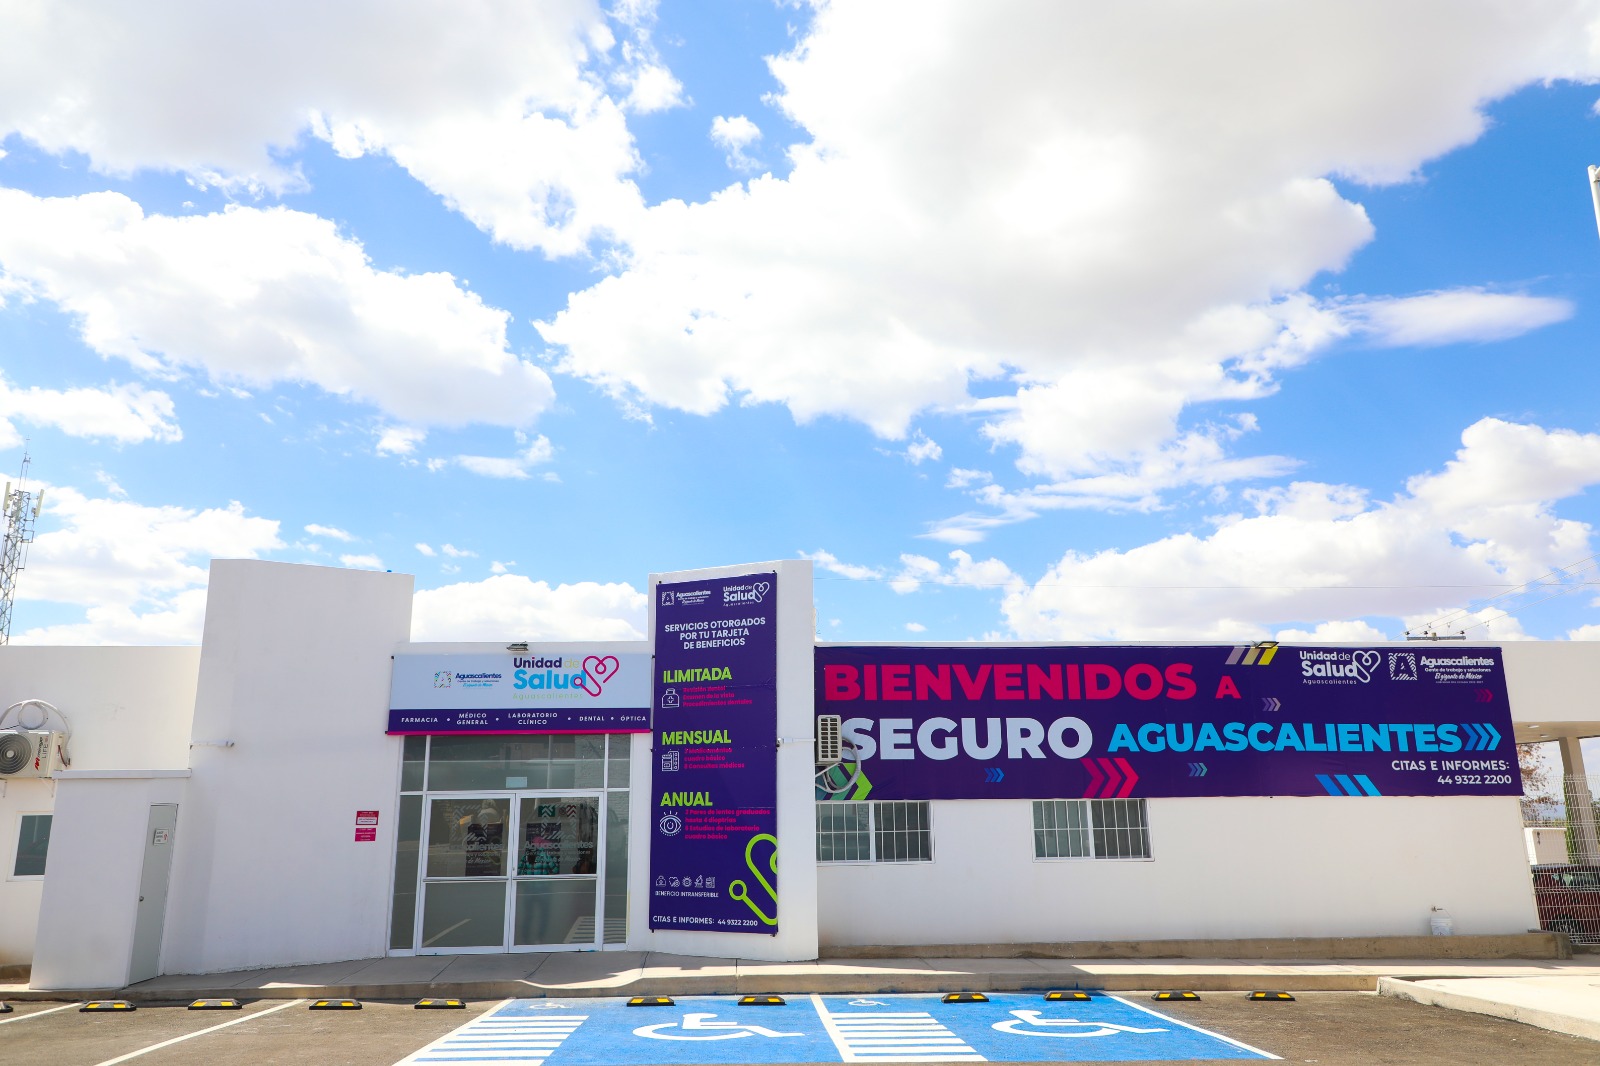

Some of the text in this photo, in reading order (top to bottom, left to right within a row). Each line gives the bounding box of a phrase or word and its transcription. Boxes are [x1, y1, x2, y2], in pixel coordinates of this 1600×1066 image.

[723, 590, 756, 602] Salud
[664, 617, 766, 632] SERVICIOS OTORGADOS
[680, 628, 750, 640] POR TU TARJETA
[684, 638, 746, 650] DE BENEFICIOS
[1300, 650, 1351, 660] Unidad de
[513, 657, 580, 668] Unidad de
[1420, 656, 1495, 668] Aguascalientes
[1301, 660, 1358, 677] Salud
[456, 672, 502, 680] Aguascalientes
[513, 669, 587, 690] Salud
[663, 667, 732, 683] ILIMITADA
[824, 664, 1242, 700] BIENVENIDOS A
[662, 730, 732, 745] MENSUAL
[841, 716, 1463, 761] SEGURO AGUASCALIENTES
[1391, 760, 1510, 771] CITAS E INFORMES:
[1438, 774, 1512, 784] 44 9322 2200
[660, 792, 713, 807] ANUAL
[678, 916, 715, 924] INFORMES:
